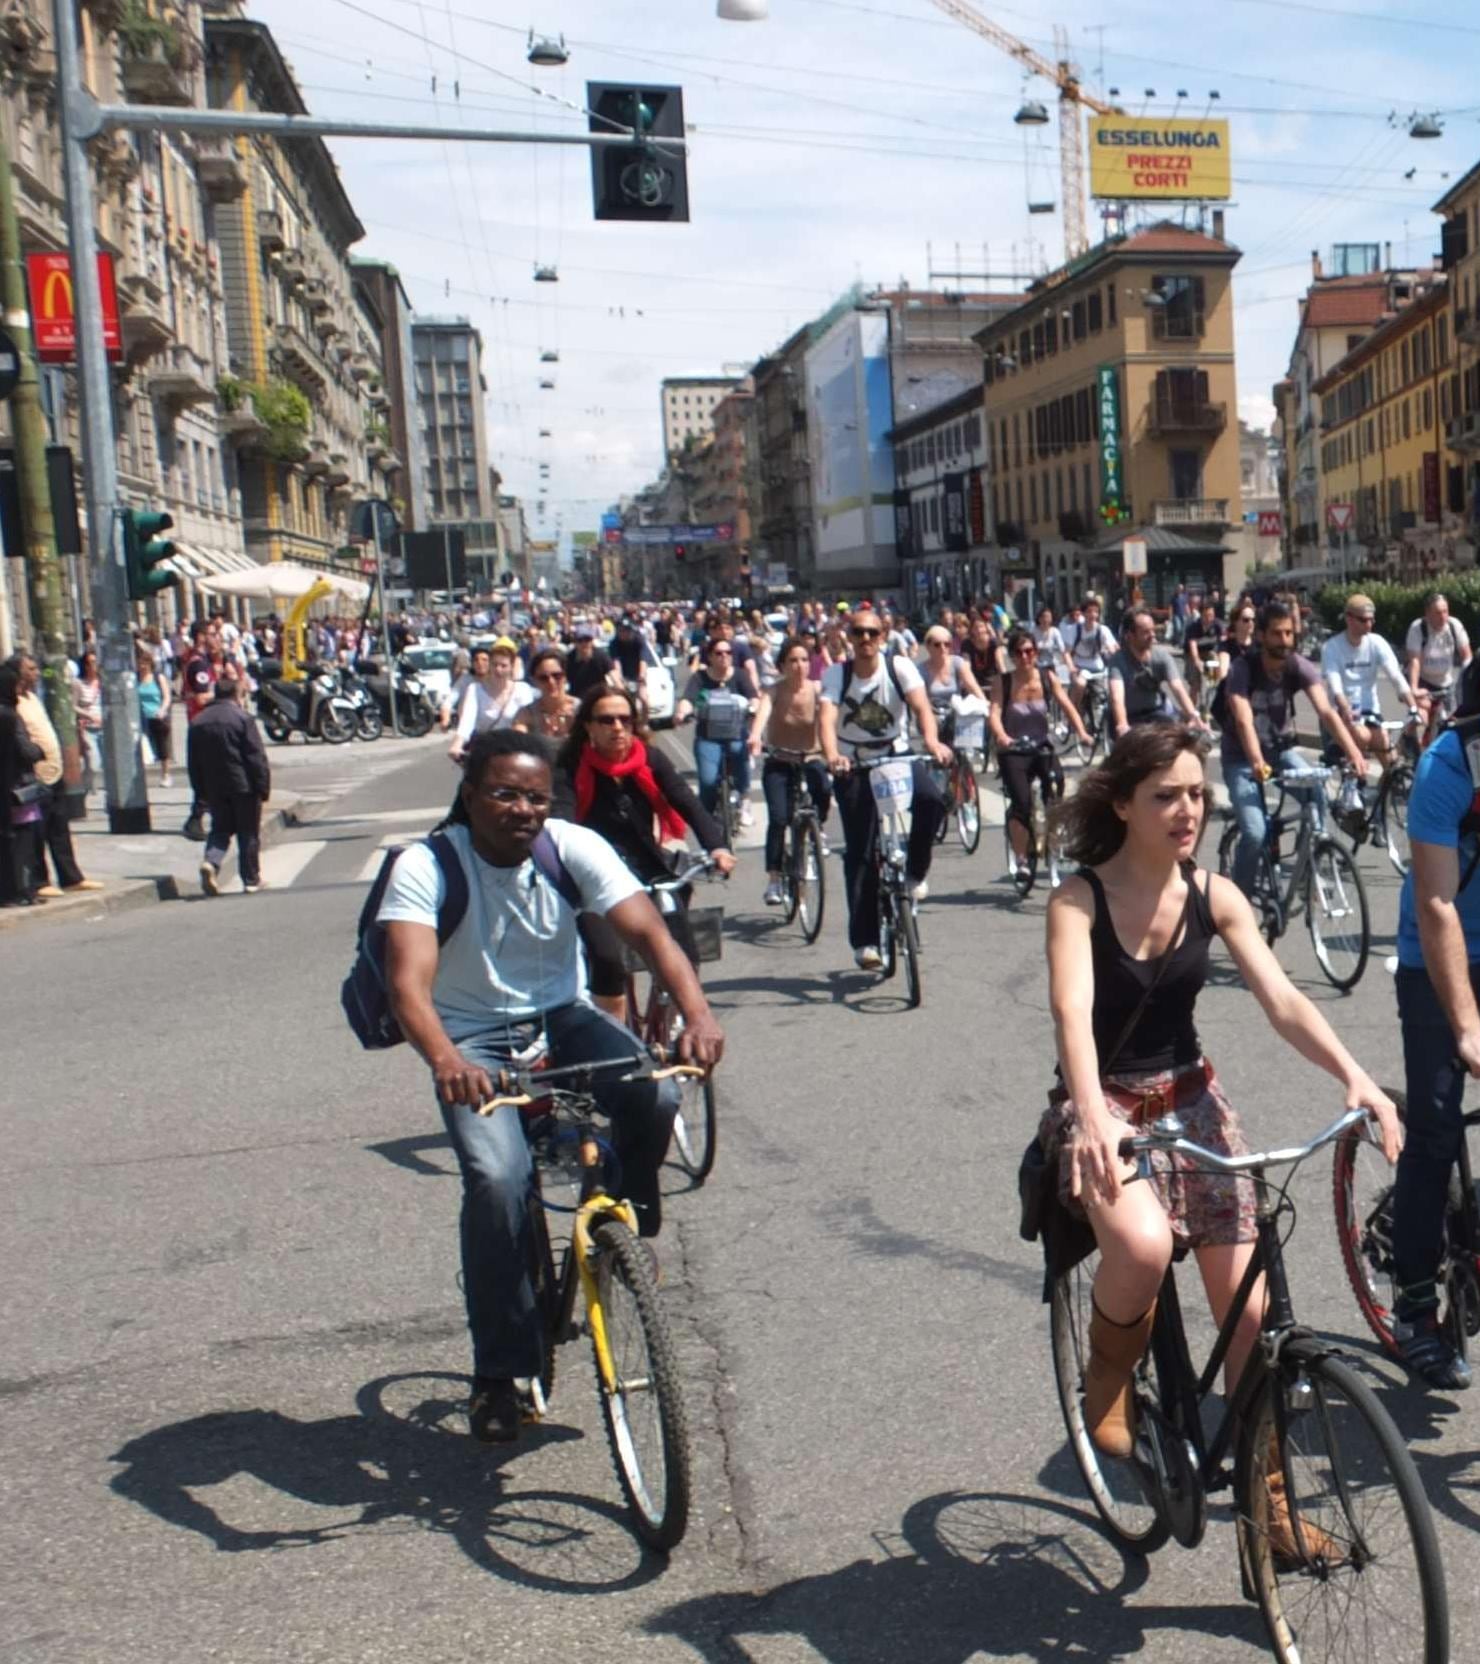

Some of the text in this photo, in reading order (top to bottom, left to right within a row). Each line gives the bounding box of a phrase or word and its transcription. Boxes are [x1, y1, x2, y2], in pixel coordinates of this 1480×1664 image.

[1097, 129, 1220, 147] ESSELUNGA
[1127, 155, 1192, 169] PREZZI
[1134, 173, 1188, 187] CORTI
[1101, 370, 1117, 492] FARMACIA
[1262, 516, 1280, 532] M
